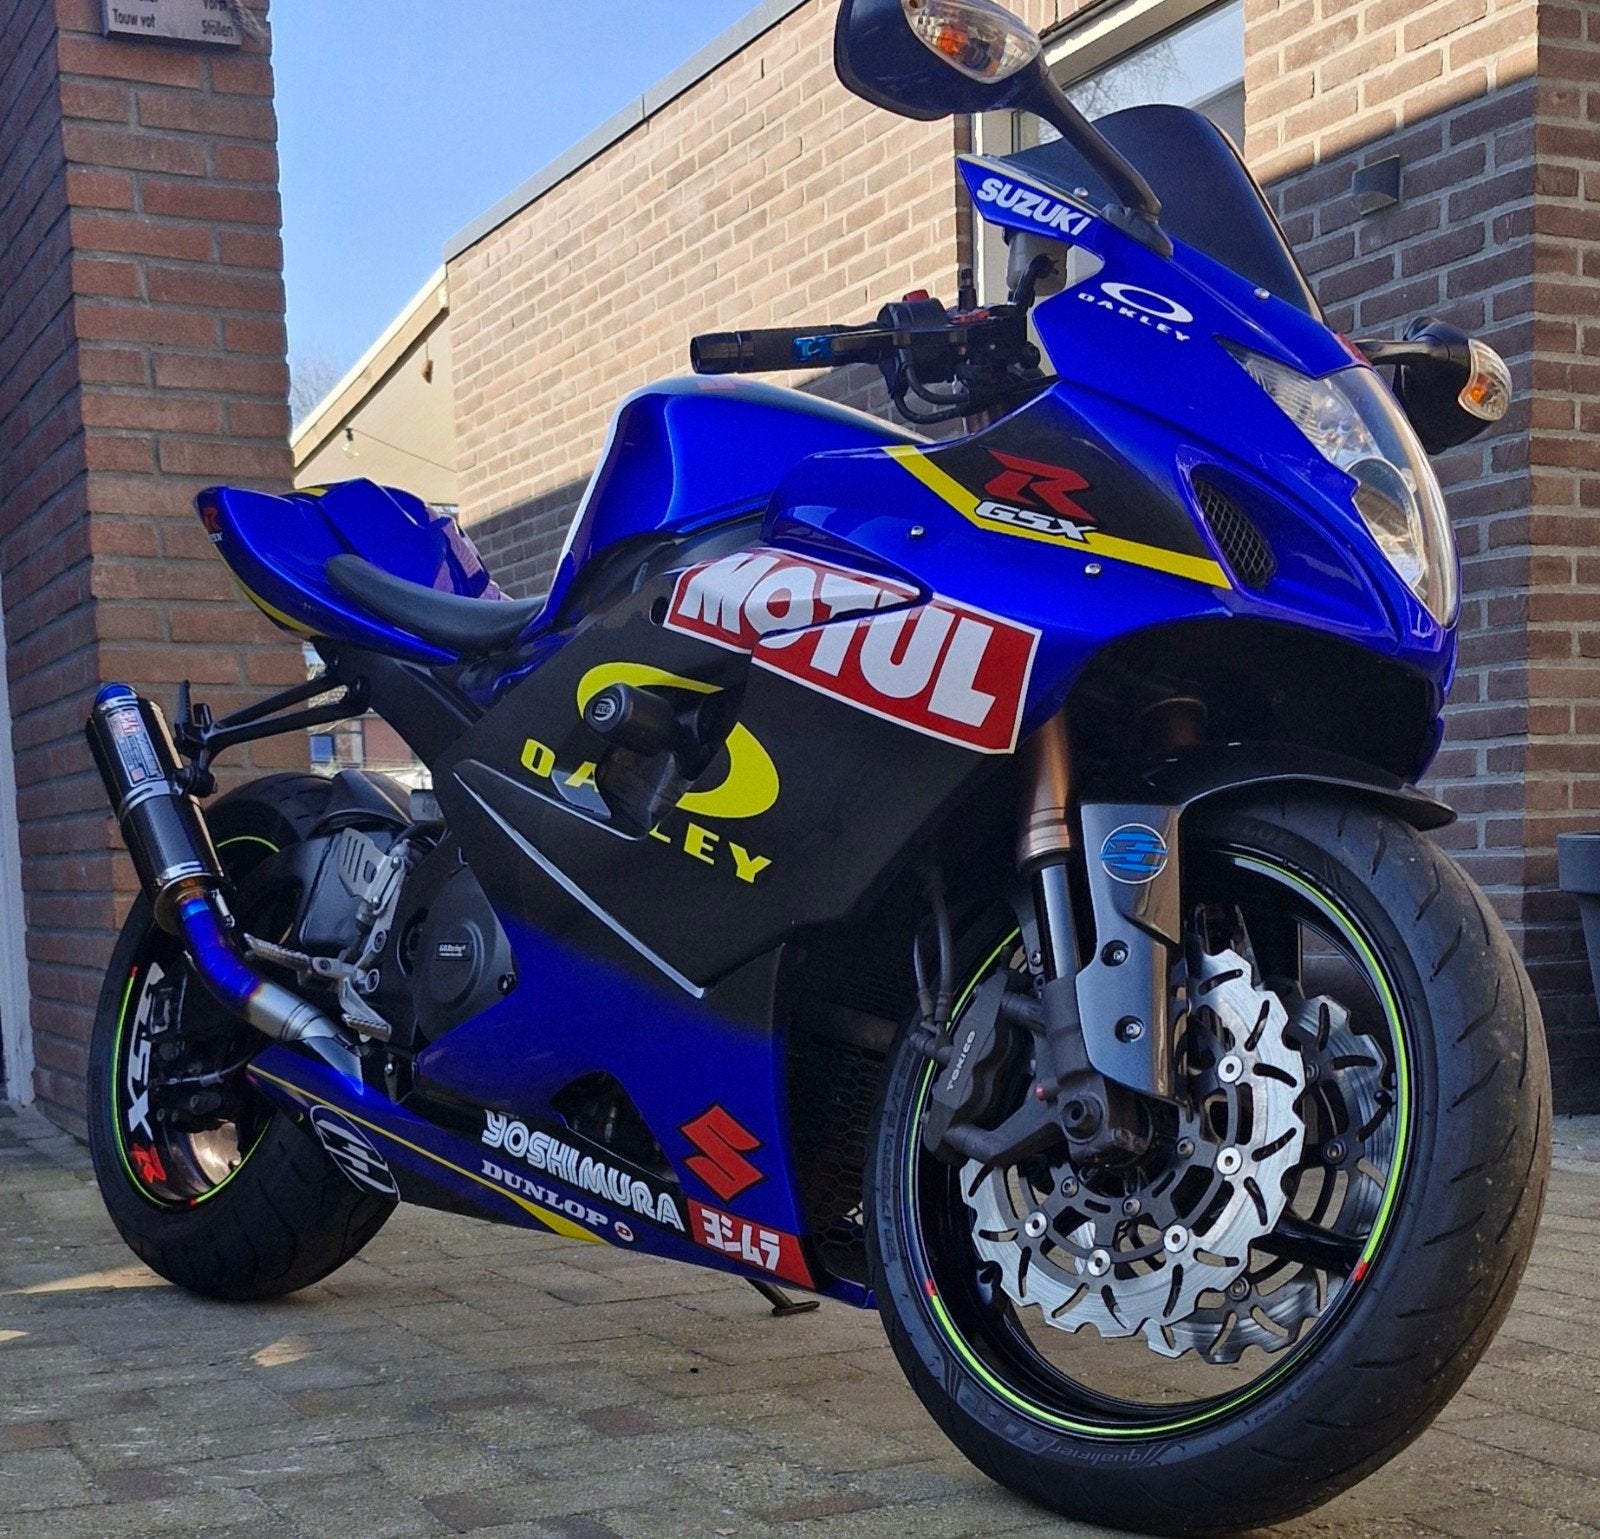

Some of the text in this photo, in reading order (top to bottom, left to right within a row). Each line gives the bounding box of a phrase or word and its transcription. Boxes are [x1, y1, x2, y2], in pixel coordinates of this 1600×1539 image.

[976, 178, 1092, 236] SUZUKI
[1077, 292, 1191, 342] OAKLEY
[984, 448, 1097, 523] R
[974, 500, 1098, 542] GSX
[677, 552, 996, 728] MOTUL
[520, 737, 773, 884] OAEY
[946, 1030, 977, 1092] TOKICO
[481, 1109, 686, 1233] YOSHIMURA
[481, 1159, 609, 1227] DUNLOP
[700, 1208, 781, 1272] ヨシムラ
